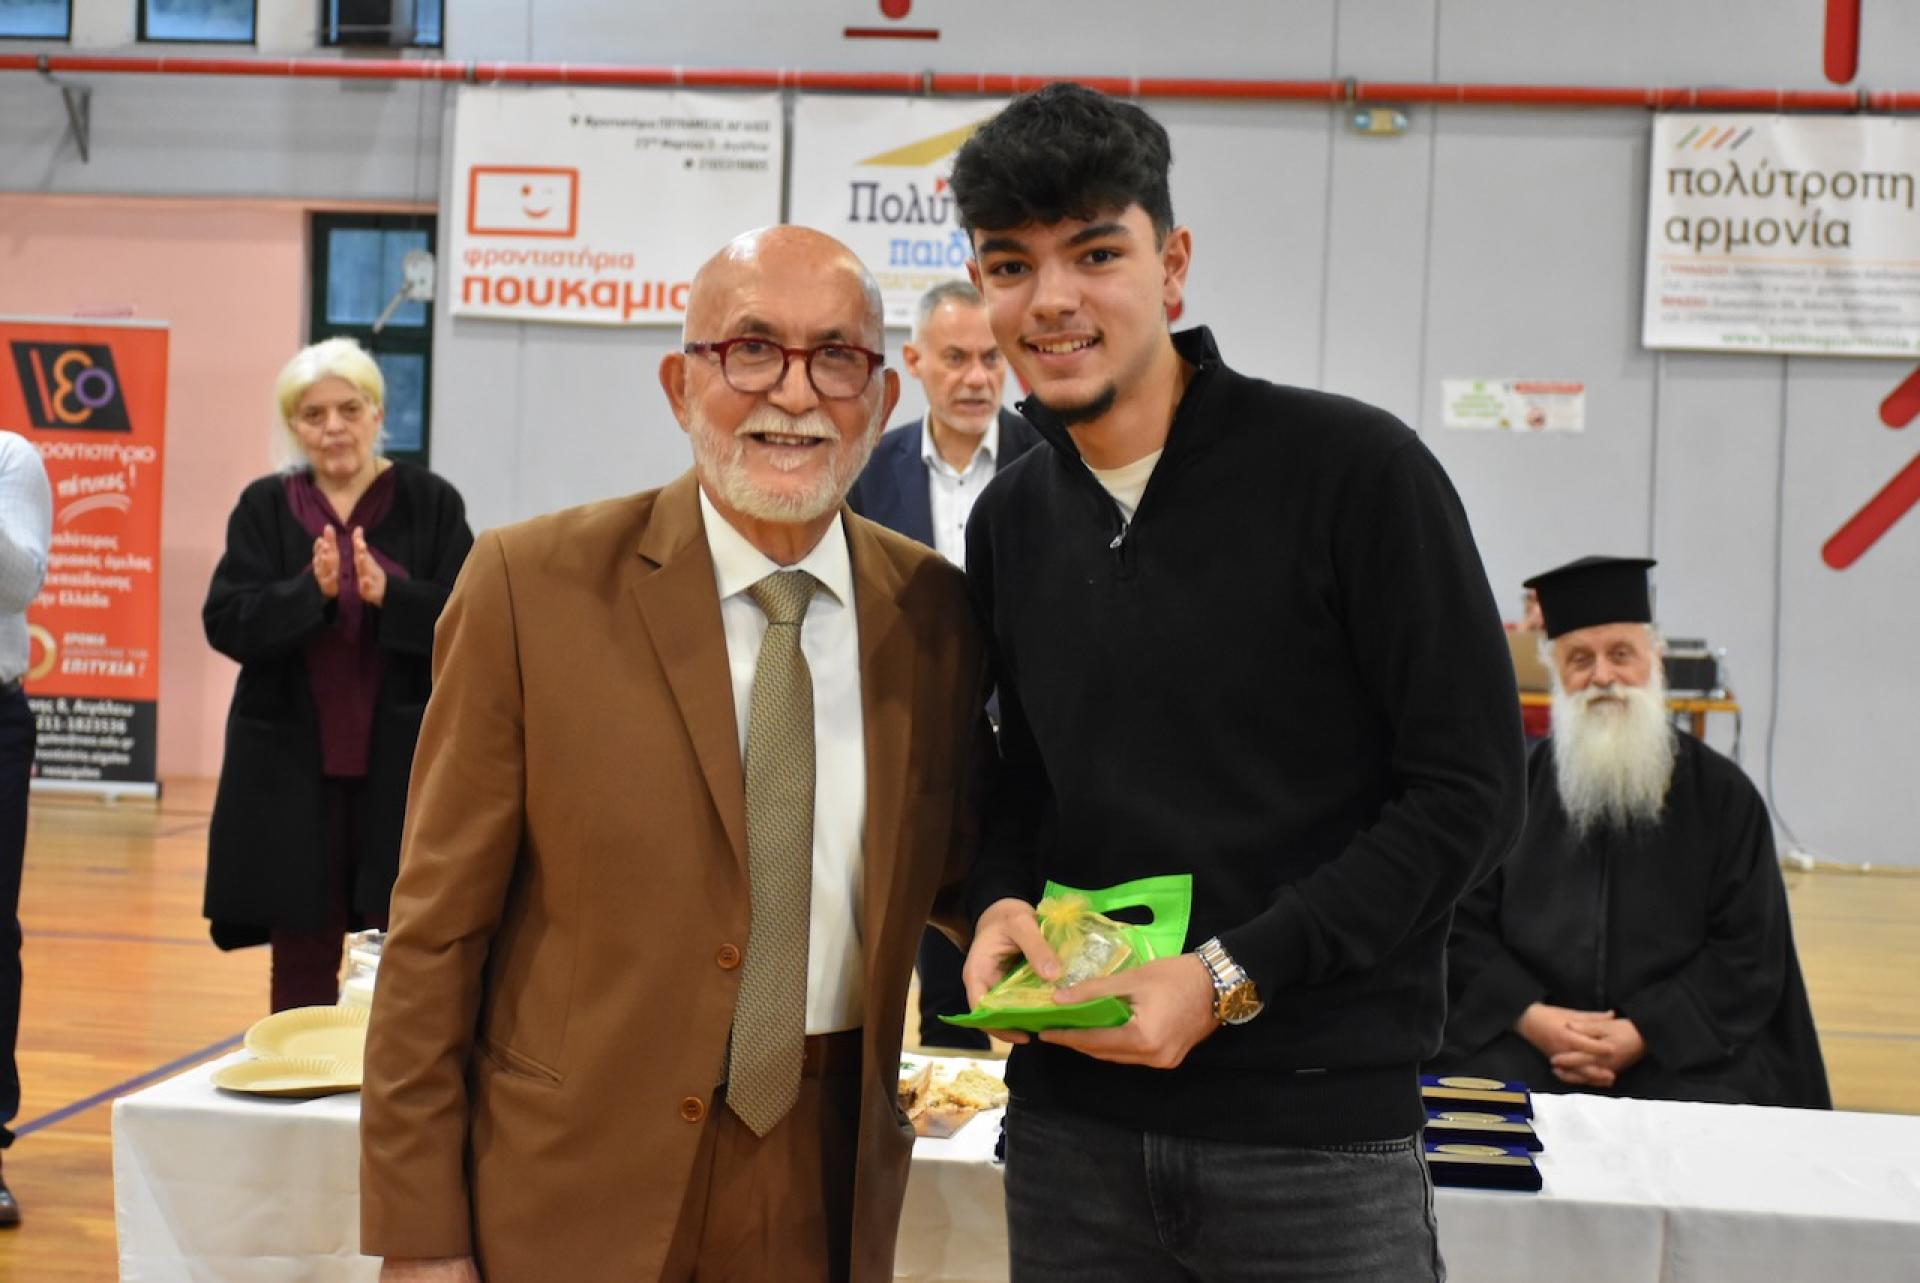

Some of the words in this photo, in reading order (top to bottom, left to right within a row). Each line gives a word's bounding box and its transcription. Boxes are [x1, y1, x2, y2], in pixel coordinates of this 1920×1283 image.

[848, 177, 955, 224] Πολύ
[1667, 158, 1915, 209] πολύτροπη
[889, 230, 967, 267] παιδ
[1664, 208, 1851, 254] αρμονία
[462, 274, 692, 320] πουκαμισ
